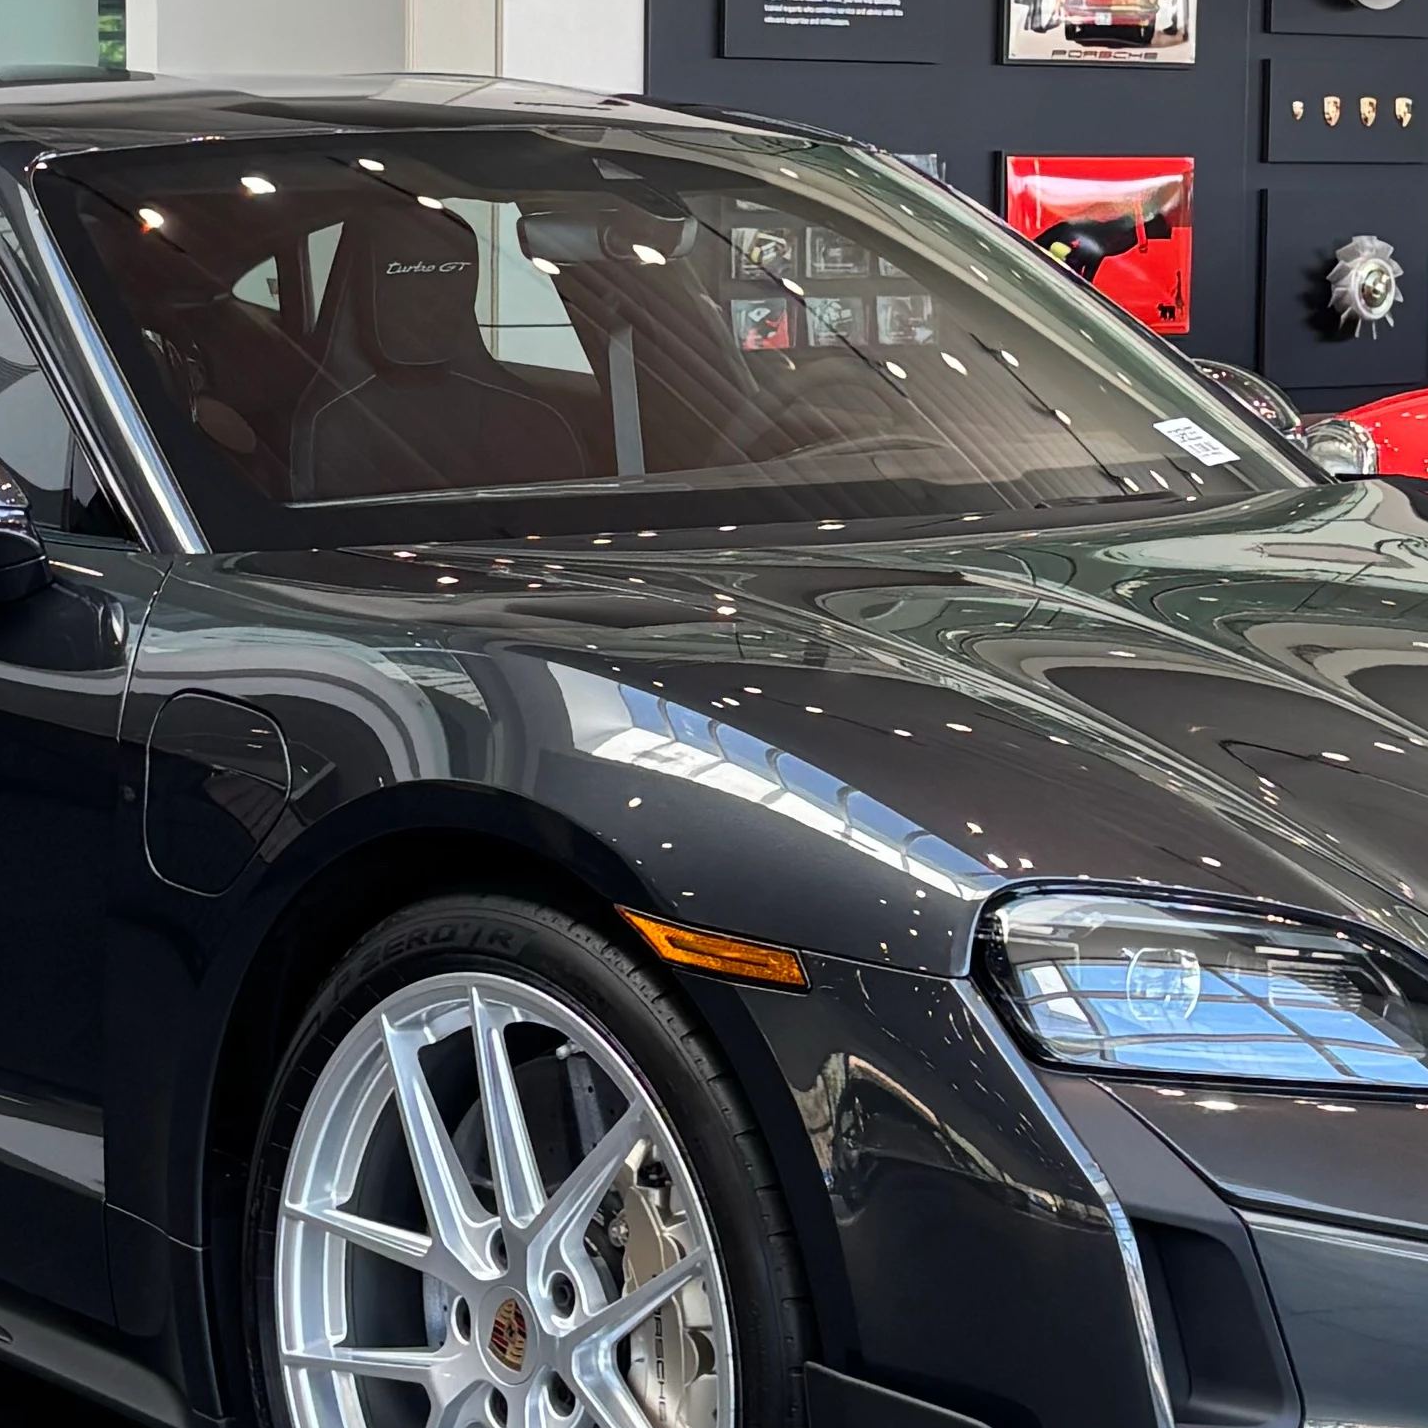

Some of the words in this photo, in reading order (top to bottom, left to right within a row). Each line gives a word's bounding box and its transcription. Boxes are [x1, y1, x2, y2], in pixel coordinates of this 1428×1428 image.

[1051, 49, 1158, 60] PORSCHE
[438, 261, 472, 273] GT
[652, 1275, 667, 1422] RSCHE
